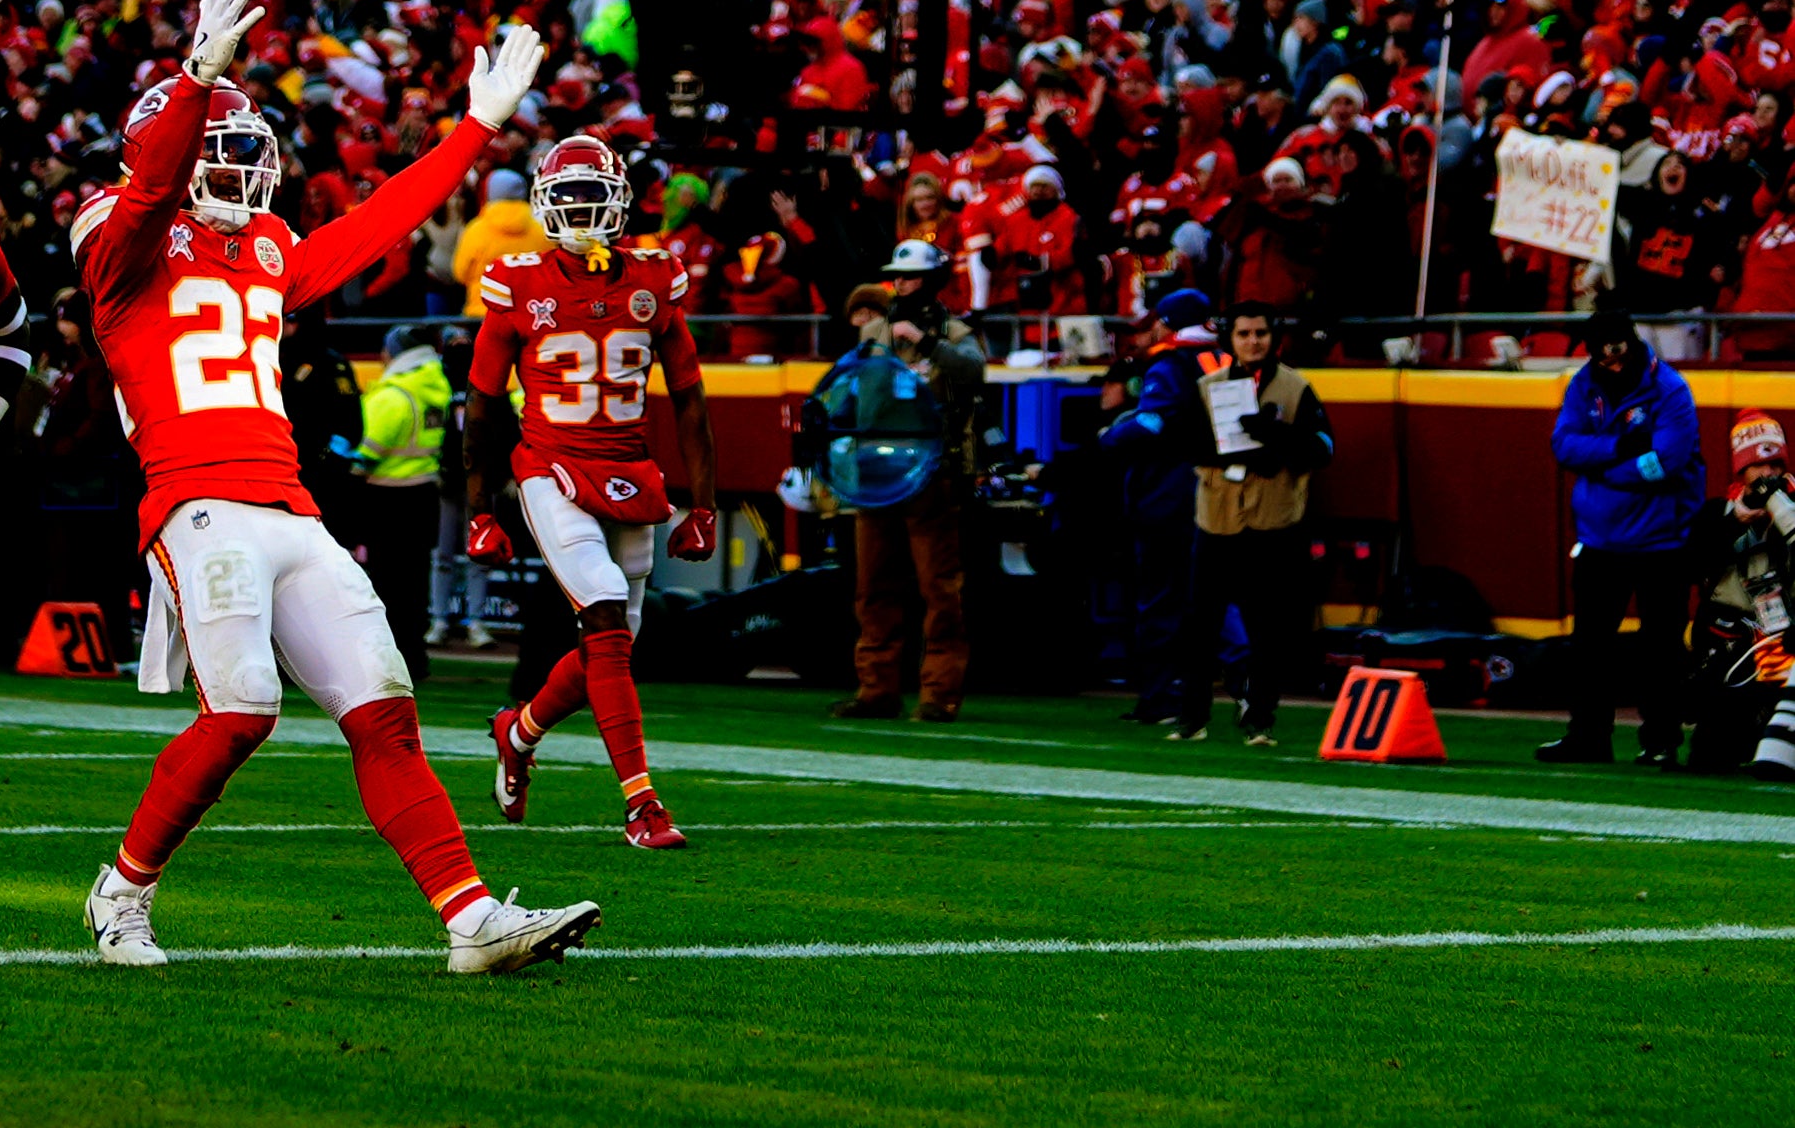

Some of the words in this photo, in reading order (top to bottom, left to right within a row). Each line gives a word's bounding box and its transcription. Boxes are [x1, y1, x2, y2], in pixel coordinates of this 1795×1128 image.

[1540, 199, 1601, 245] #22
[168, 276, 289, 422] 22
[536, 329, 652, 423] 39
[53, 612, 114, 672] 20
[1334, 677, 1402, 751] 10
